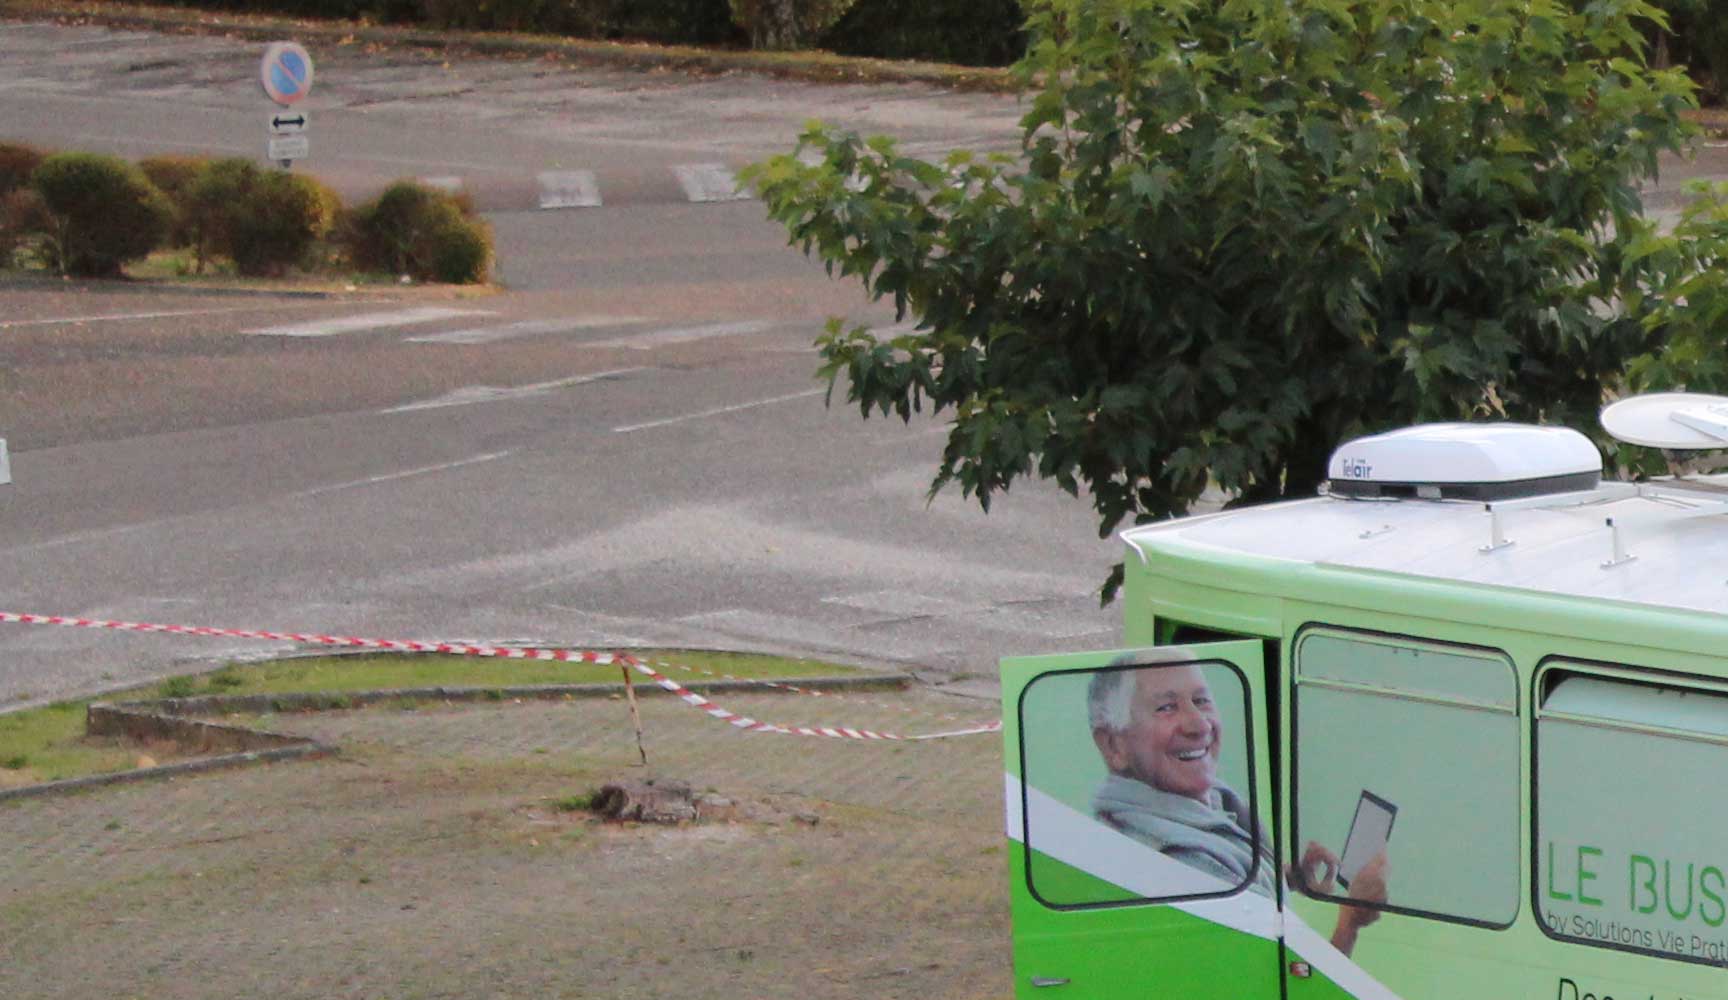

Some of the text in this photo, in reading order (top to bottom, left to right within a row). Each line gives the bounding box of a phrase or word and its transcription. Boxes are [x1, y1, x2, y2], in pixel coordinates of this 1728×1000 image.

[1548, 841, 1603, 906] LE
[1629, 853, 1726, 928] BUS
[1547, 910, 1568, 932] by
[1572, 915, 1653, 948] Solutions
[1656, 931, 1686, 952] Vie
